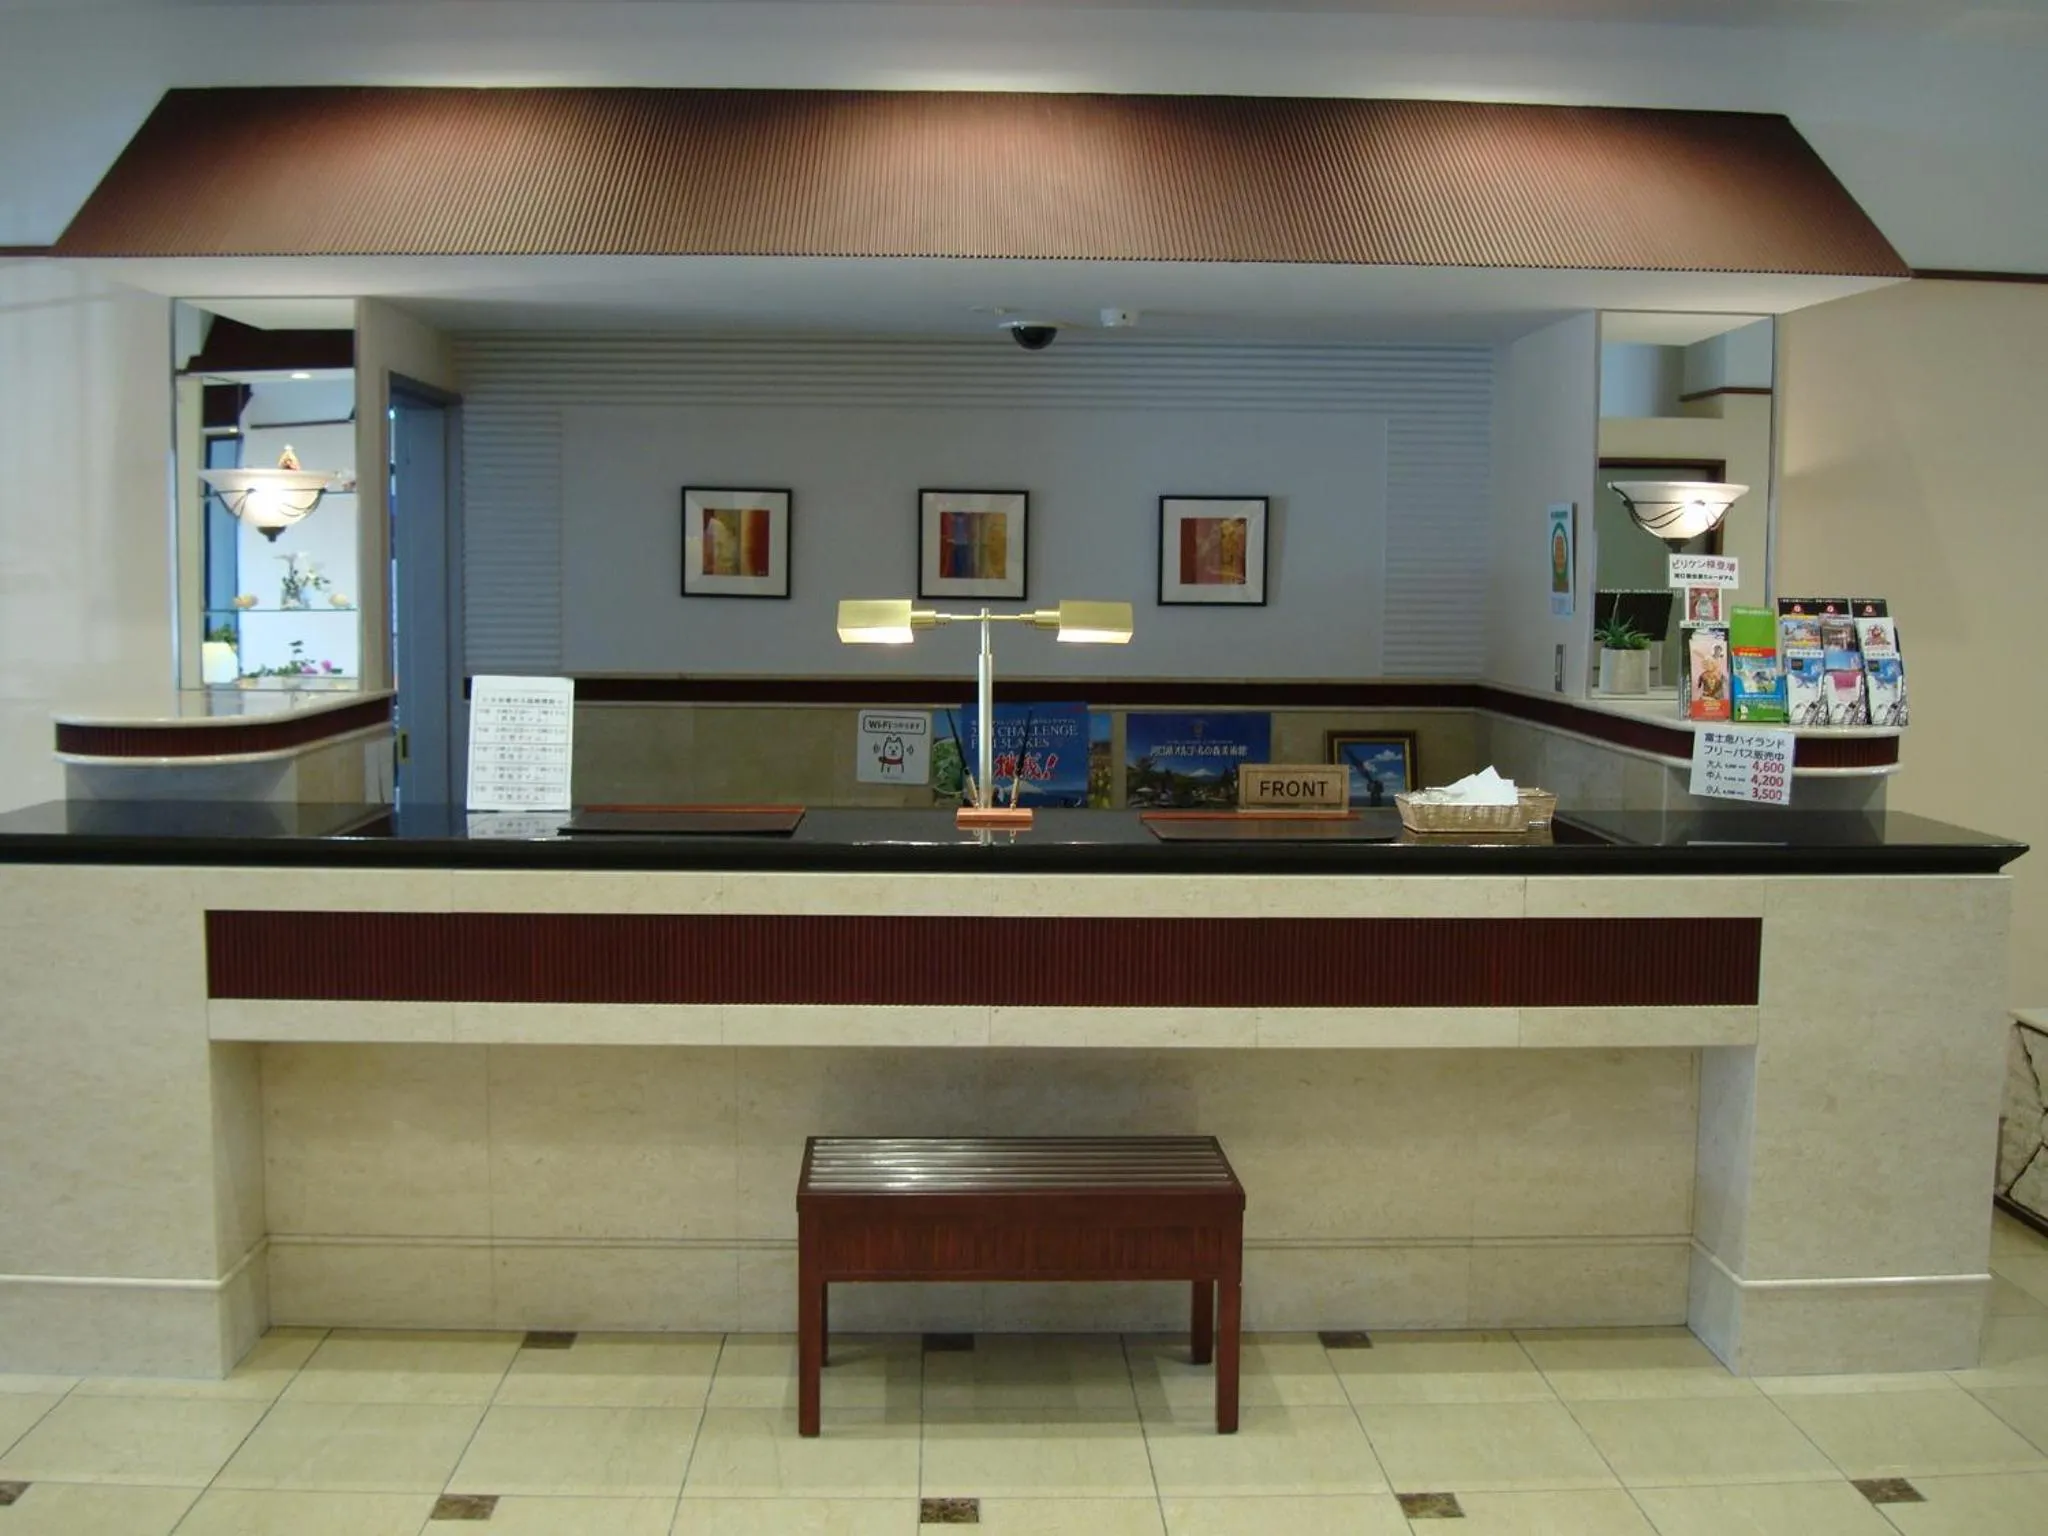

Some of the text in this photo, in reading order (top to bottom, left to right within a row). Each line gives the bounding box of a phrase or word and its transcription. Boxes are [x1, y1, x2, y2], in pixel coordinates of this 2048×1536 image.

[1704, 732, 1785, 749] 富士急ハイランド
[1704, 745, 1785, 761] フリーパス販売中
[1752, 761, 1785, 774] 4,600
[1751, 774, 1784, 787] 4,200
[1259, 780, 1329, 797] FRONT
[1752, 787, 1782, 800] 3,500
